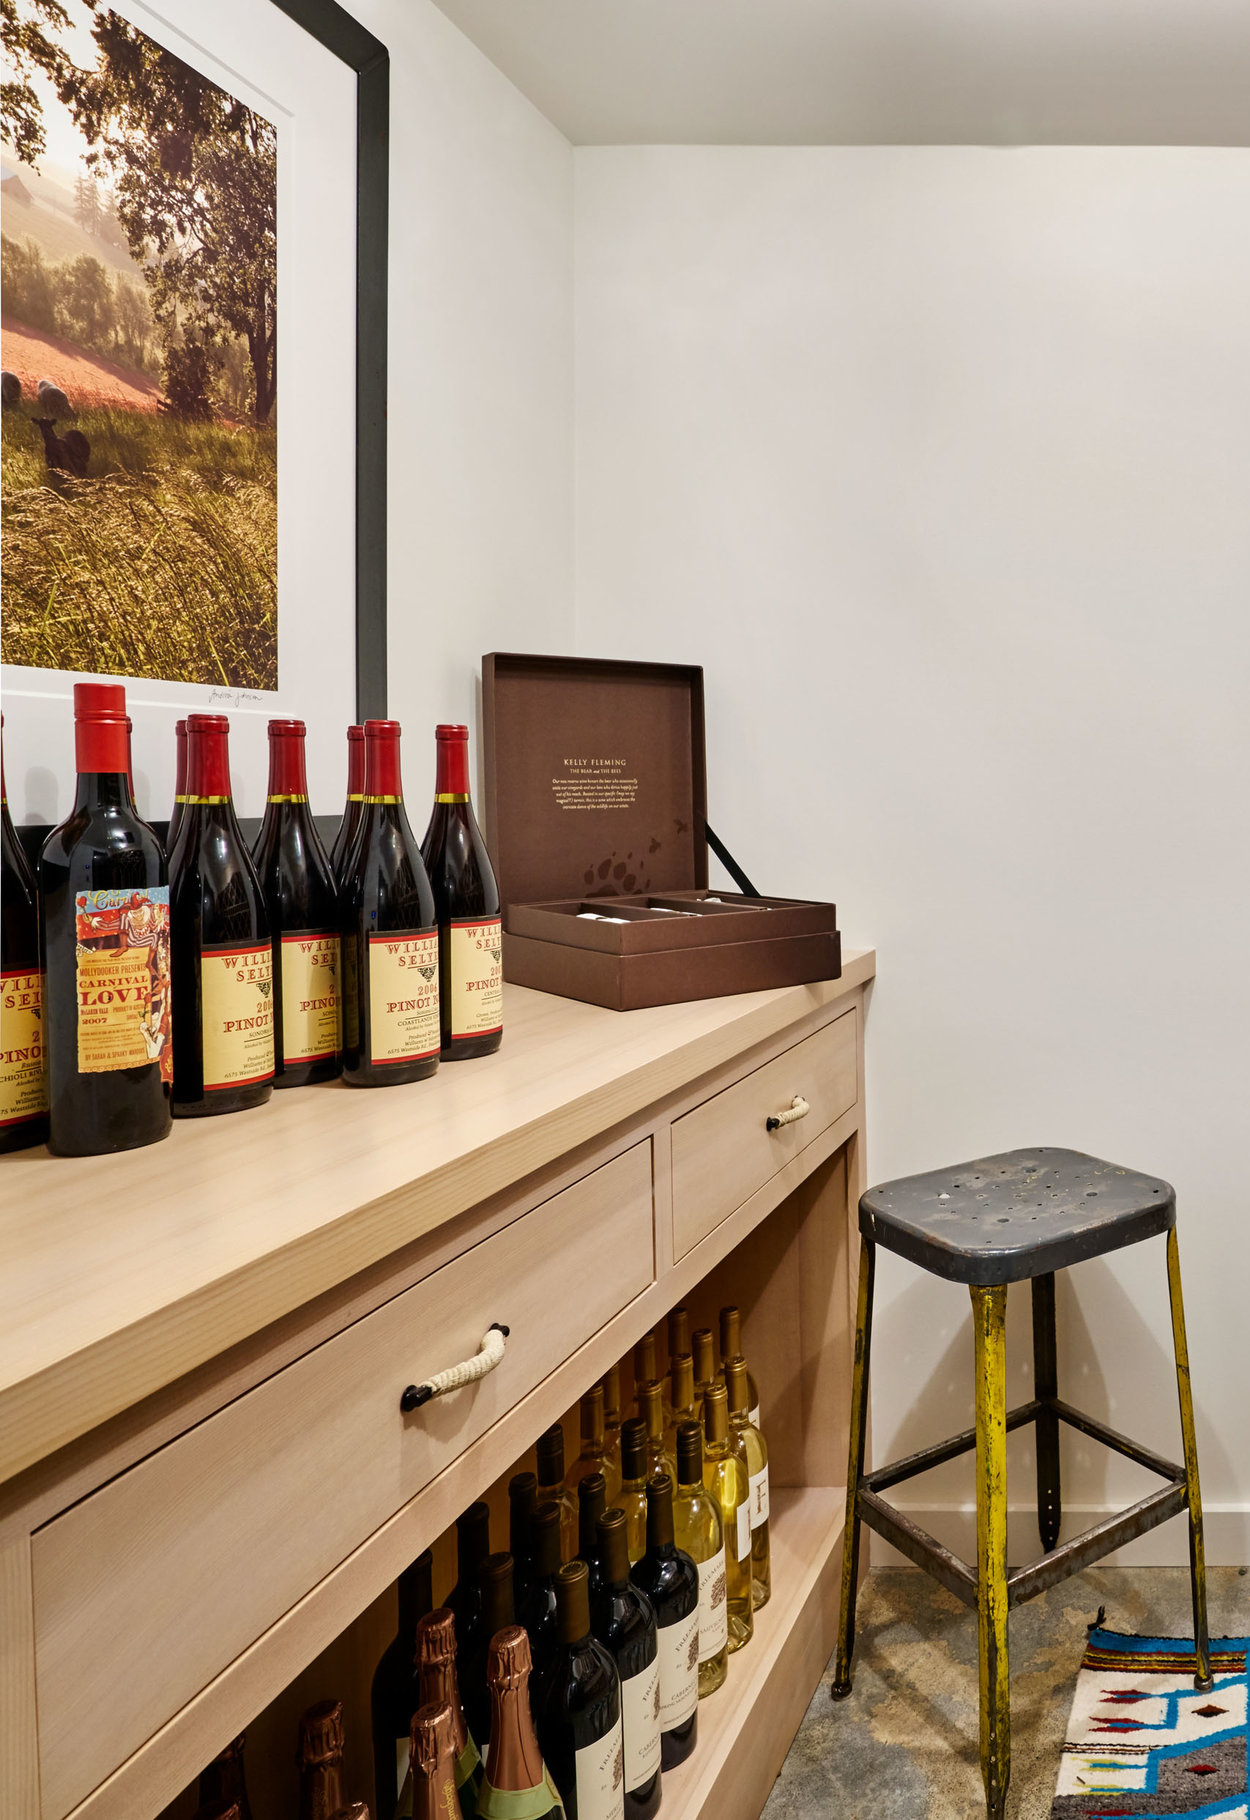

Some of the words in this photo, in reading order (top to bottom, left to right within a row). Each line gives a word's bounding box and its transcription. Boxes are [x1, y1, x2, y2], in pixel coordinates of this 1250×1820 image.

[79, 975, 148, 988] CARNIVAL
[466, 977, 499, 991] PINOT
[80, 986, 149, 1006] LOVE
[386, 997, 430, 1013] PINOT
[82, 1016, 108, 1025] 2007
[223, 1014, 270, 1033] PINOT
